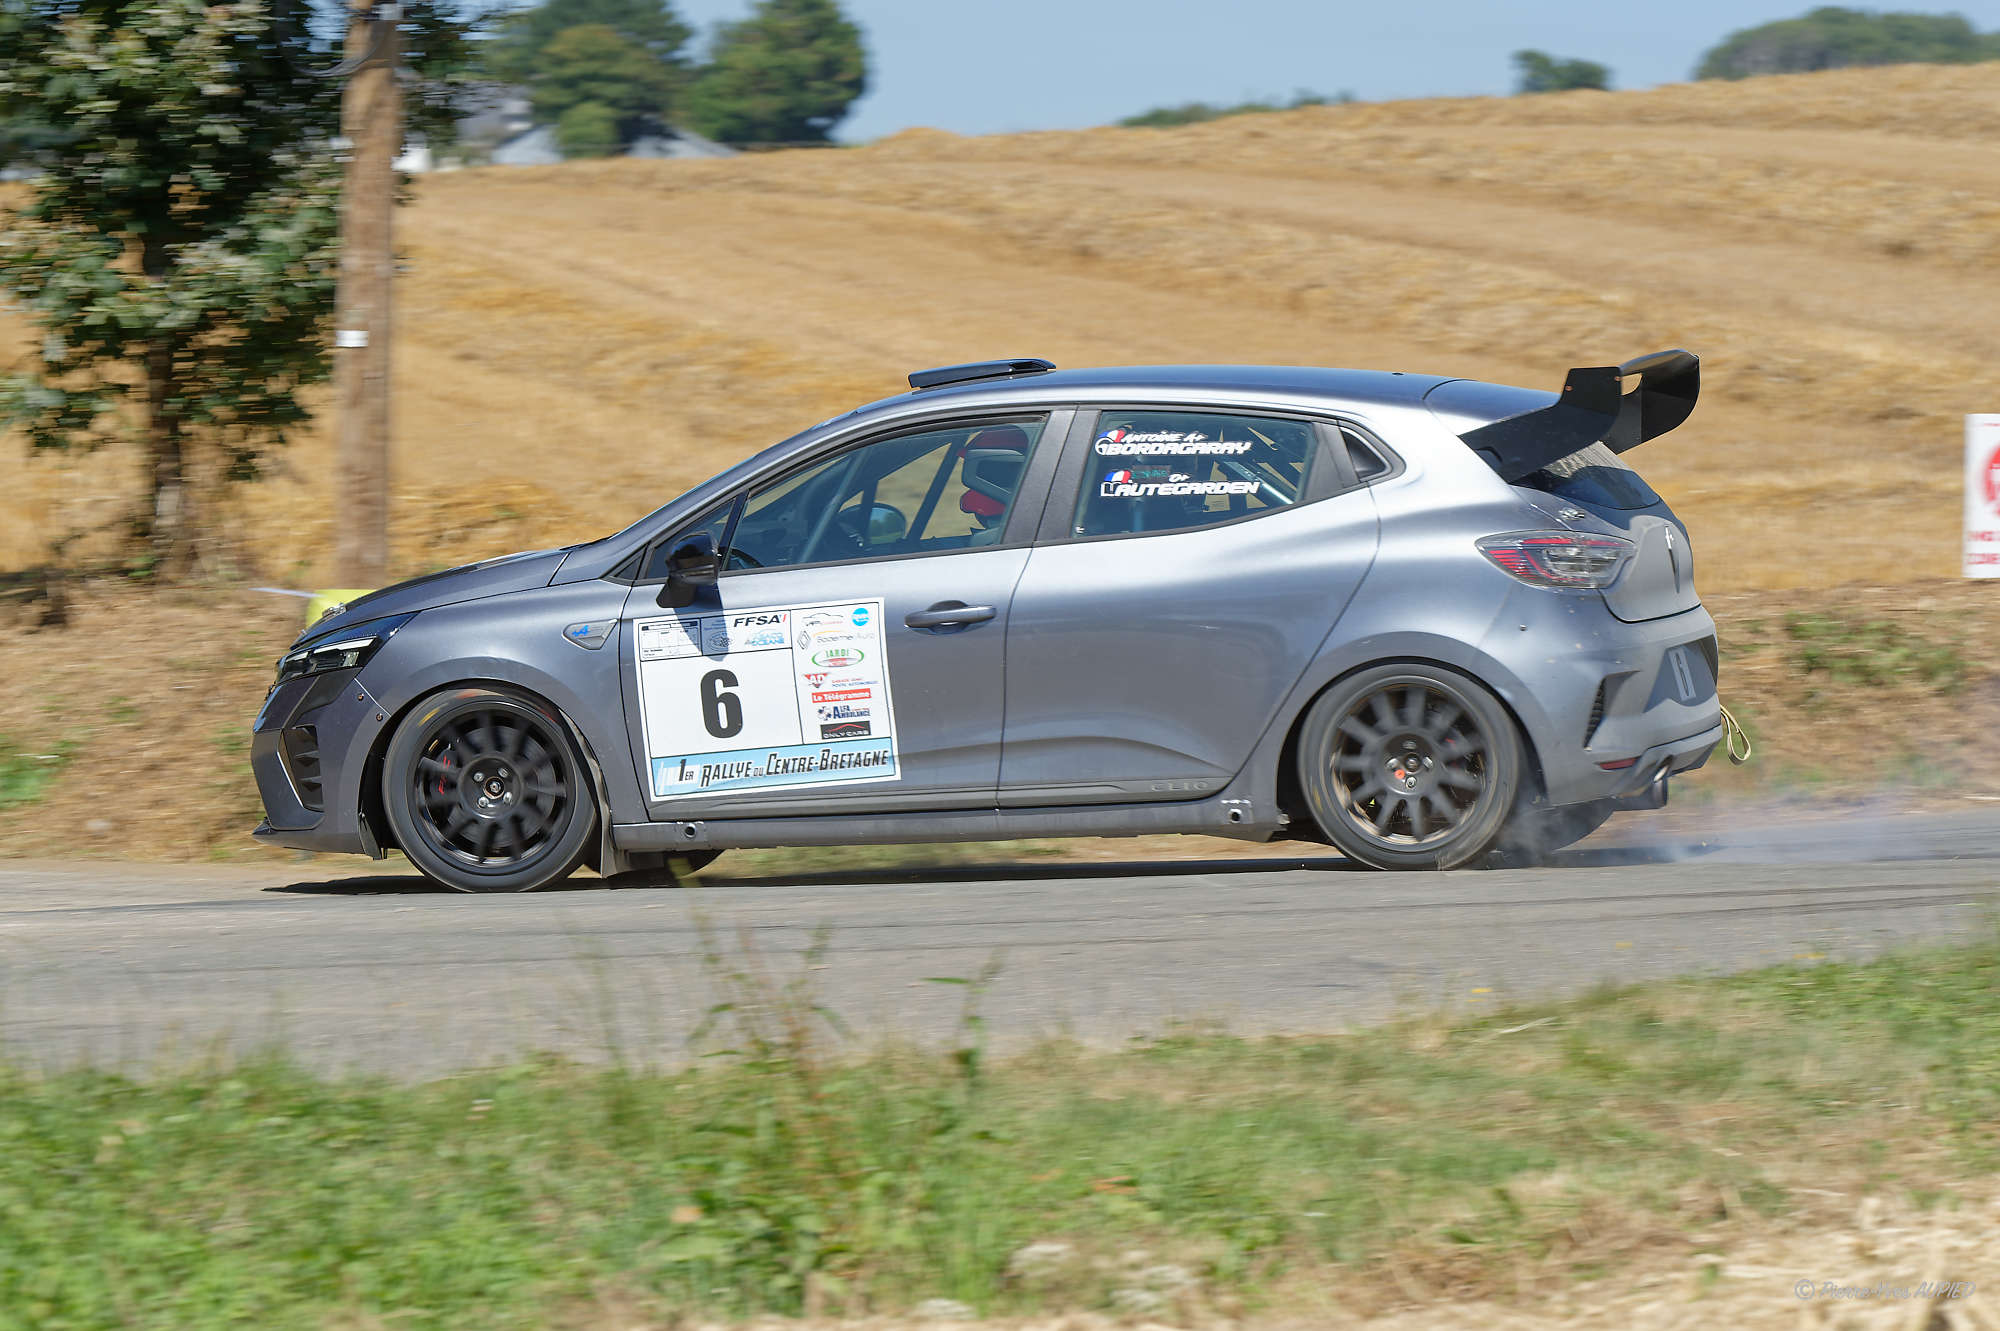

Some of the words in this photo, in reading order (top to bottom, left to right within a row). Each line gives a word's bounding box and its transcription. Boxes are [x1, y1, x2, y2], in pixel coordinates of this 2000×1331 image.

[1121, 430, 1184, 443] ANTOINE
[734, 614, 781, 628] FFSA
[813, 693, 824, 701] Le
[700, 669, 743, 739] 6
[701, 760, 752, 788] RALLYE
[753, 766, 764, 777] DU
[1151, 781, 1208, 792] CLIO
